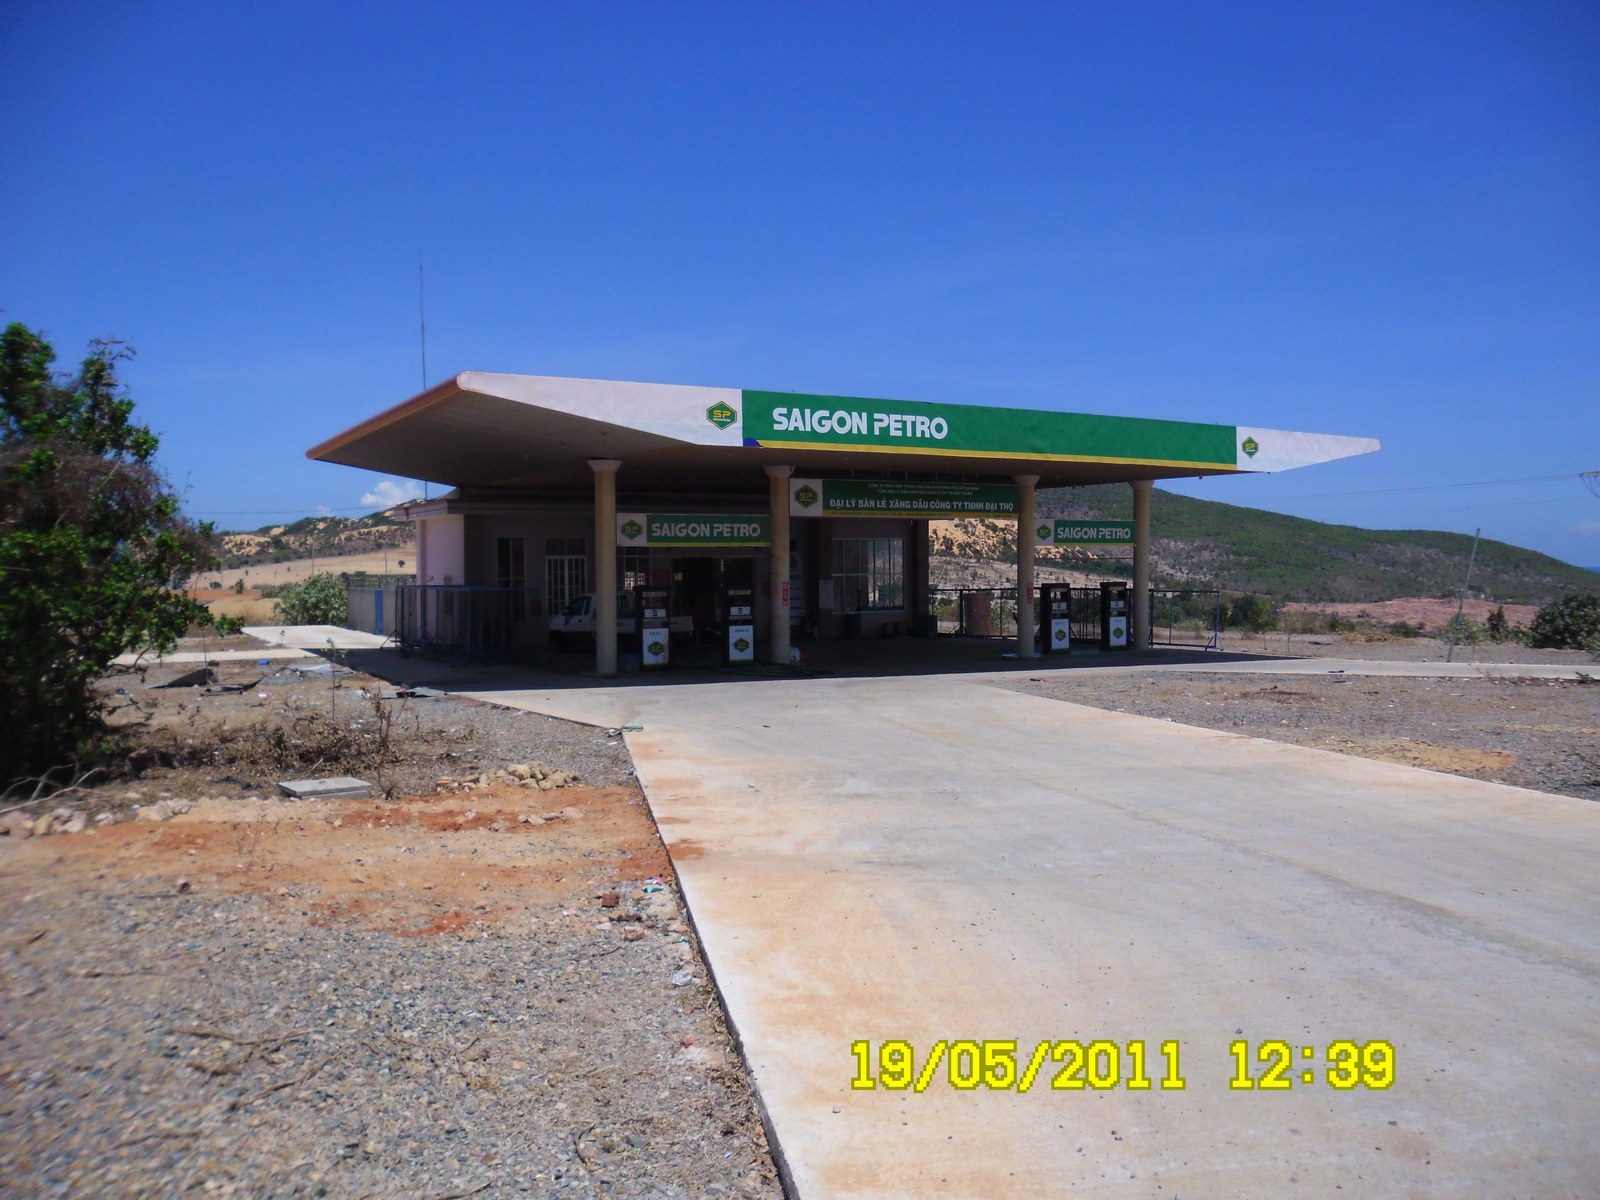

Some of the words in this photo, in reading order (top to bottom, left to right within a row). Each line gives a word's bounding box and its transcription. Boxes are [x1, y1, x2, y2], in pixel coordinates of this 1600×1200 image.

[713, 410, 731, 419] SP
[772, 407, 868, 435] SAIGON
[873, 413, 949, 440] PETRO
[846, 497, 856, 508] LÝ
[929, 499, 951, 509] CÔNG
[953, 501, 962, 509] TY
[963, 501, 984, 510] TNHH
[985, 502, 997, 511] ĐẠI
[651, 522, 710, 537] SAIGON
[713, 523, 761, 537] PETRO
[1057, 527, 1096, 539] SAIGON
[1098, 527, 1131, 539] PETRO
